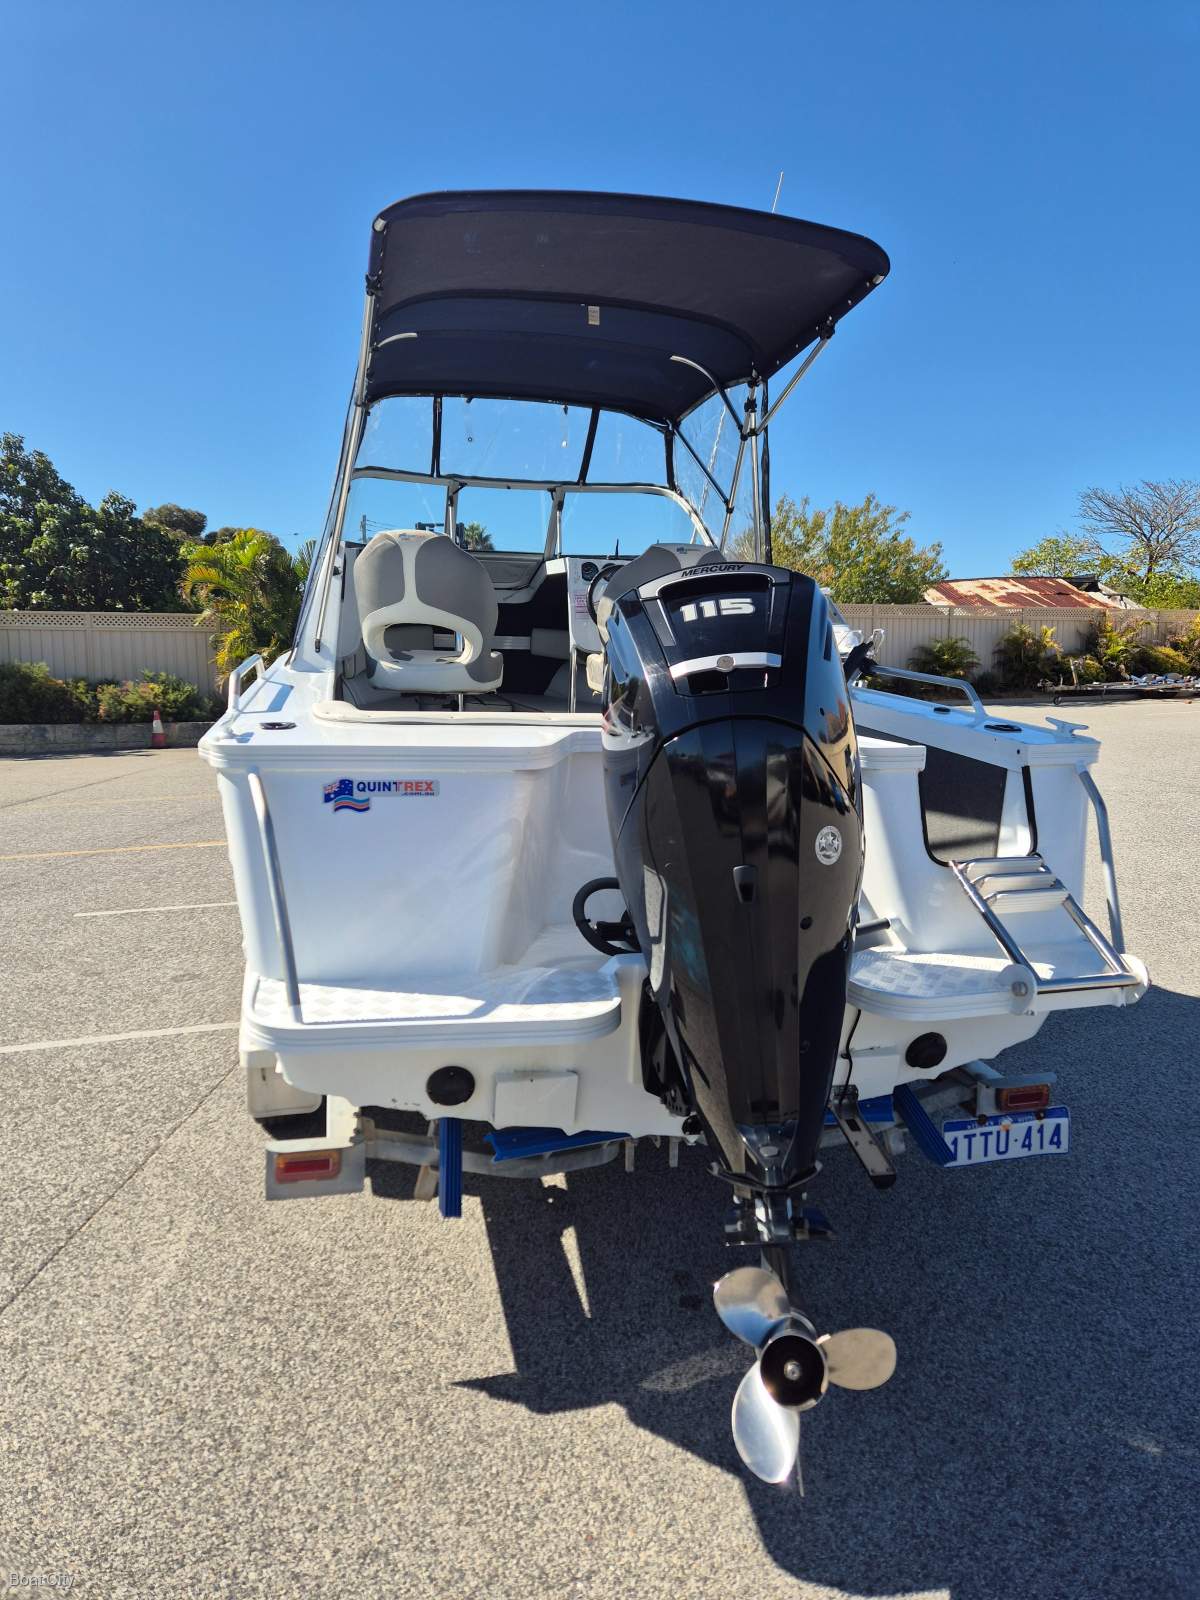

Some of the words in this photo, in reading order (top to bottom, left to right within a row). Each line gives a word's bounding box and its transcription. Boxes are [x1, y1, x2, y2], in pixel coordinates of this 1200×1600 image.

[680, 564, 744, 578] MERCURY
[680, 597, 756, 623] 115
[356, 781, 433, 793] QUINTREX
